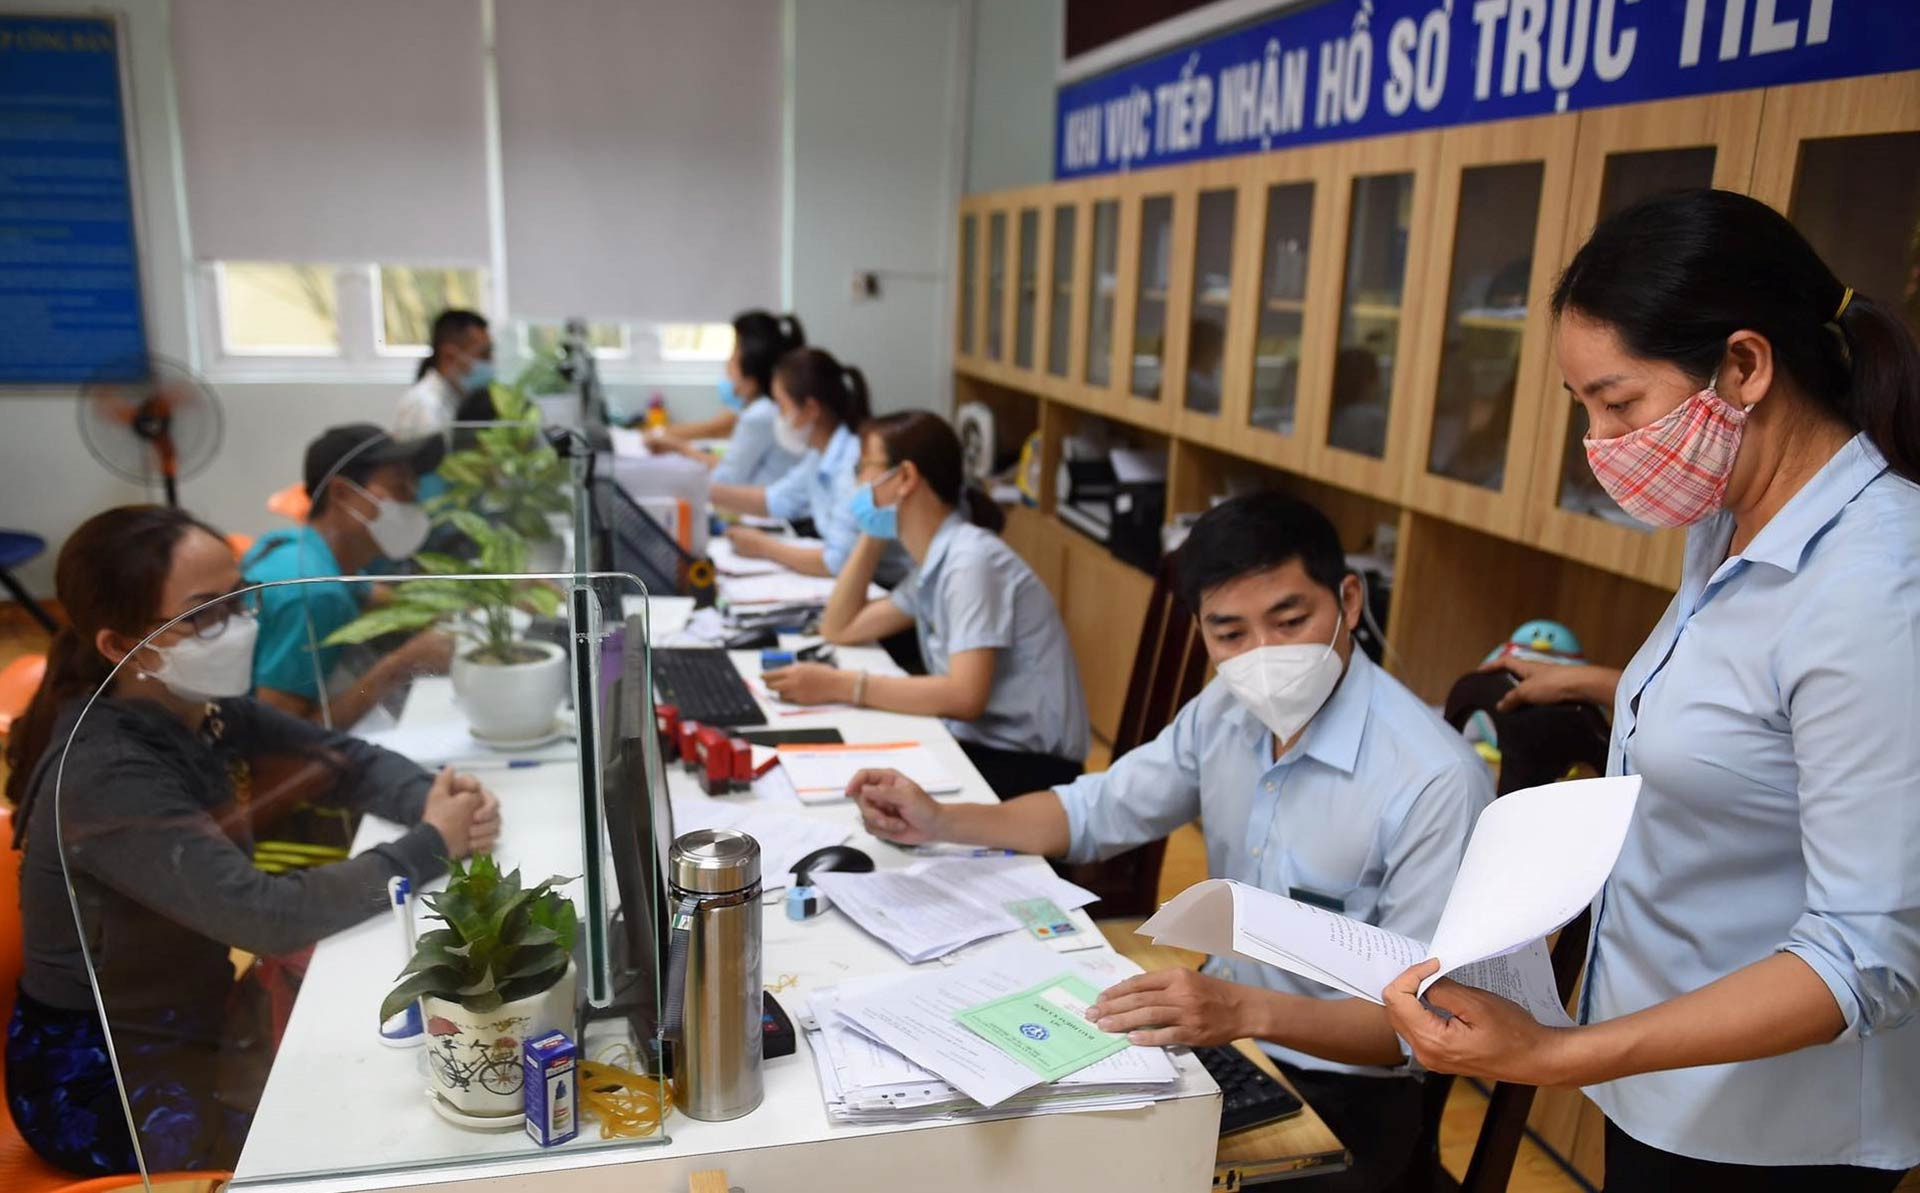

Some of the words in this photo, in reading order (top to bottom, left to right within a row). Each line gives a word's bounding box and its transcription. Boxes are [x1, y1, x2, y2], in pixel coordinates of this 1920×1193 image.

[1064, 104, 1102, 171] KHU
[1105, 84, 1151, 173] VỰC
[1154, 55, 1213, 155] TIẾP
[1216, 38, 1308, 149] NHẬN
[1314, 0, 1374, 128] HỒ
[1383, 0, 1454, 117] SƠ
